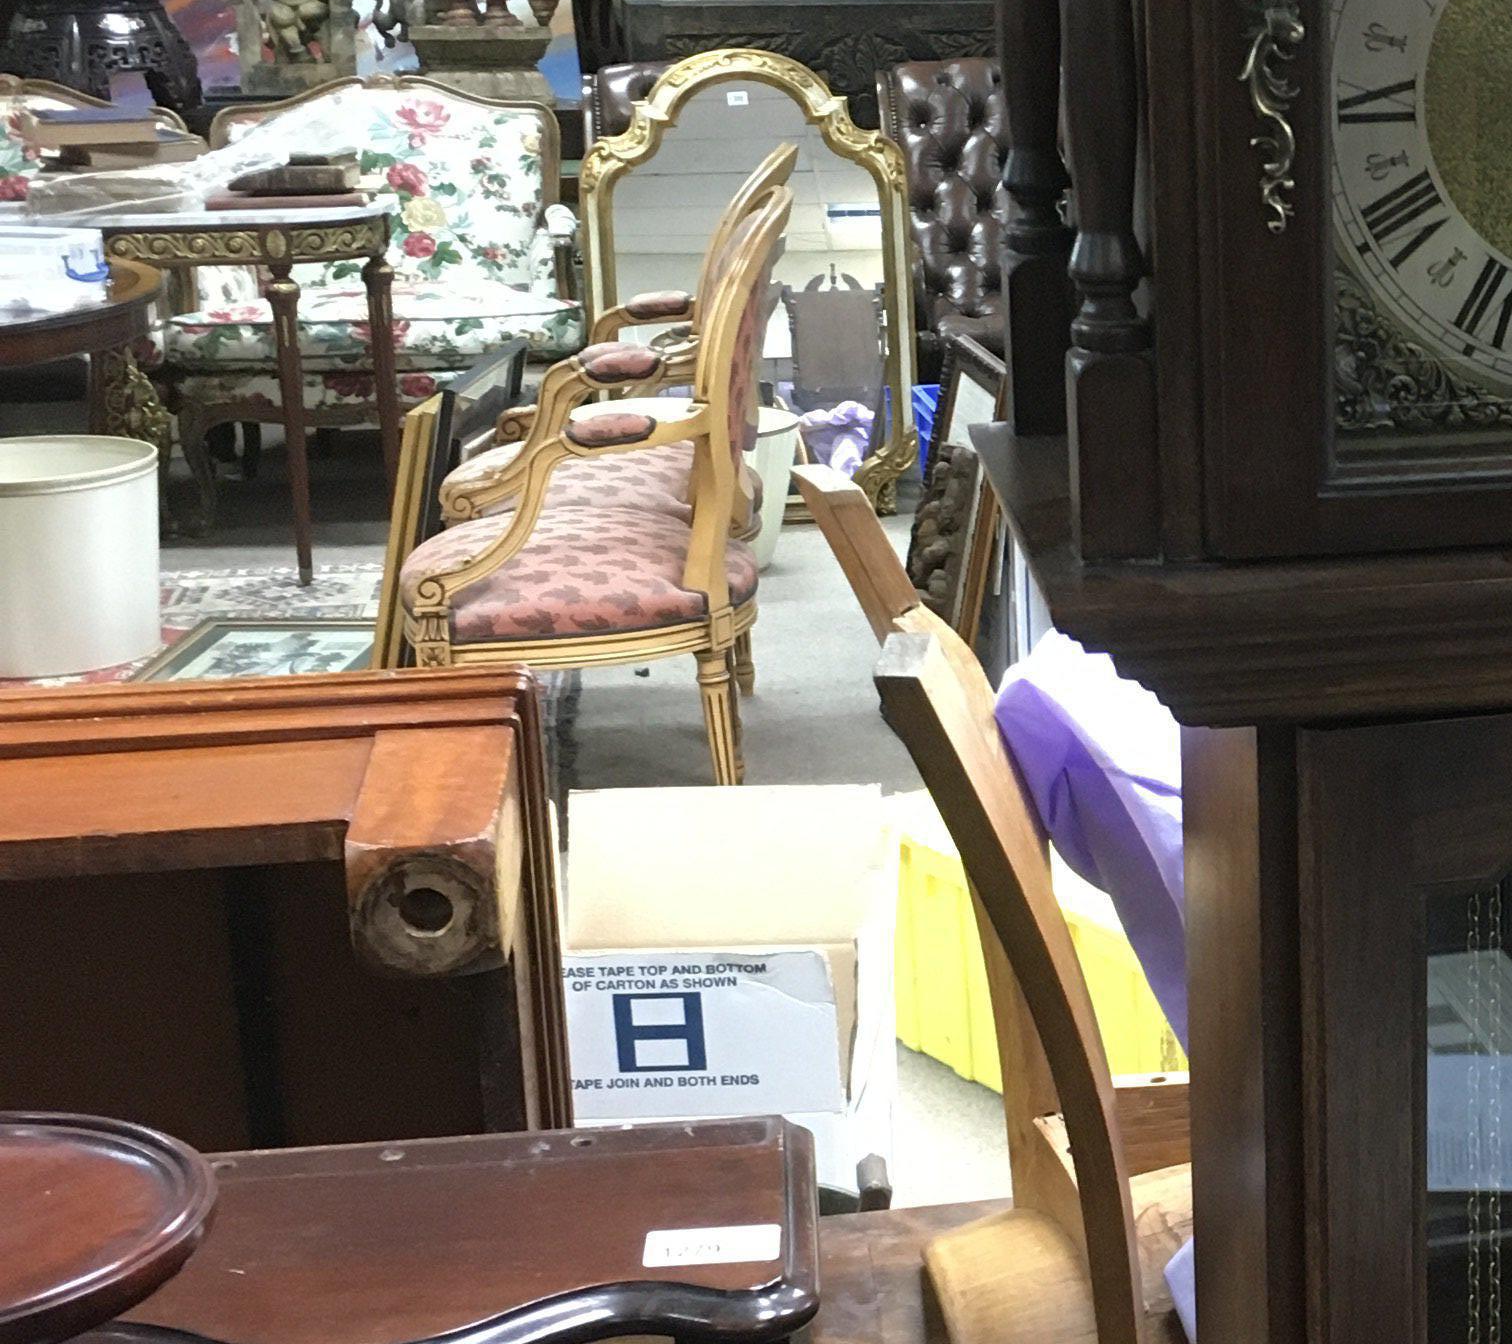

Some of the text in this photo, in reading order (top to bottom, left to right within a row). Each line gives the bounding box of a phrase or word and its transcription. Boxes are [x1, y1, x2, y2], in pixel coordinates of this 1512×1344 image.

[1337, 73, 1417, 130] IX
[1360, 167, 1451, 272] VIII
[598, 966, 635, 977] TAPE
[638, 965, 667, 976] TOP
[672, 964, 701, 975] AND
[706, 963, 767, 975] BOTTOM
[572, 976, 737, 992] OF CARTON AS SHOWN
[606, 1078, 639, 1089] JOIN
[644, 1077, 673, 1088] AND
[678, 1076, 717, 1087] BOTH
[721, 1074, 760, 1086] ENDS
